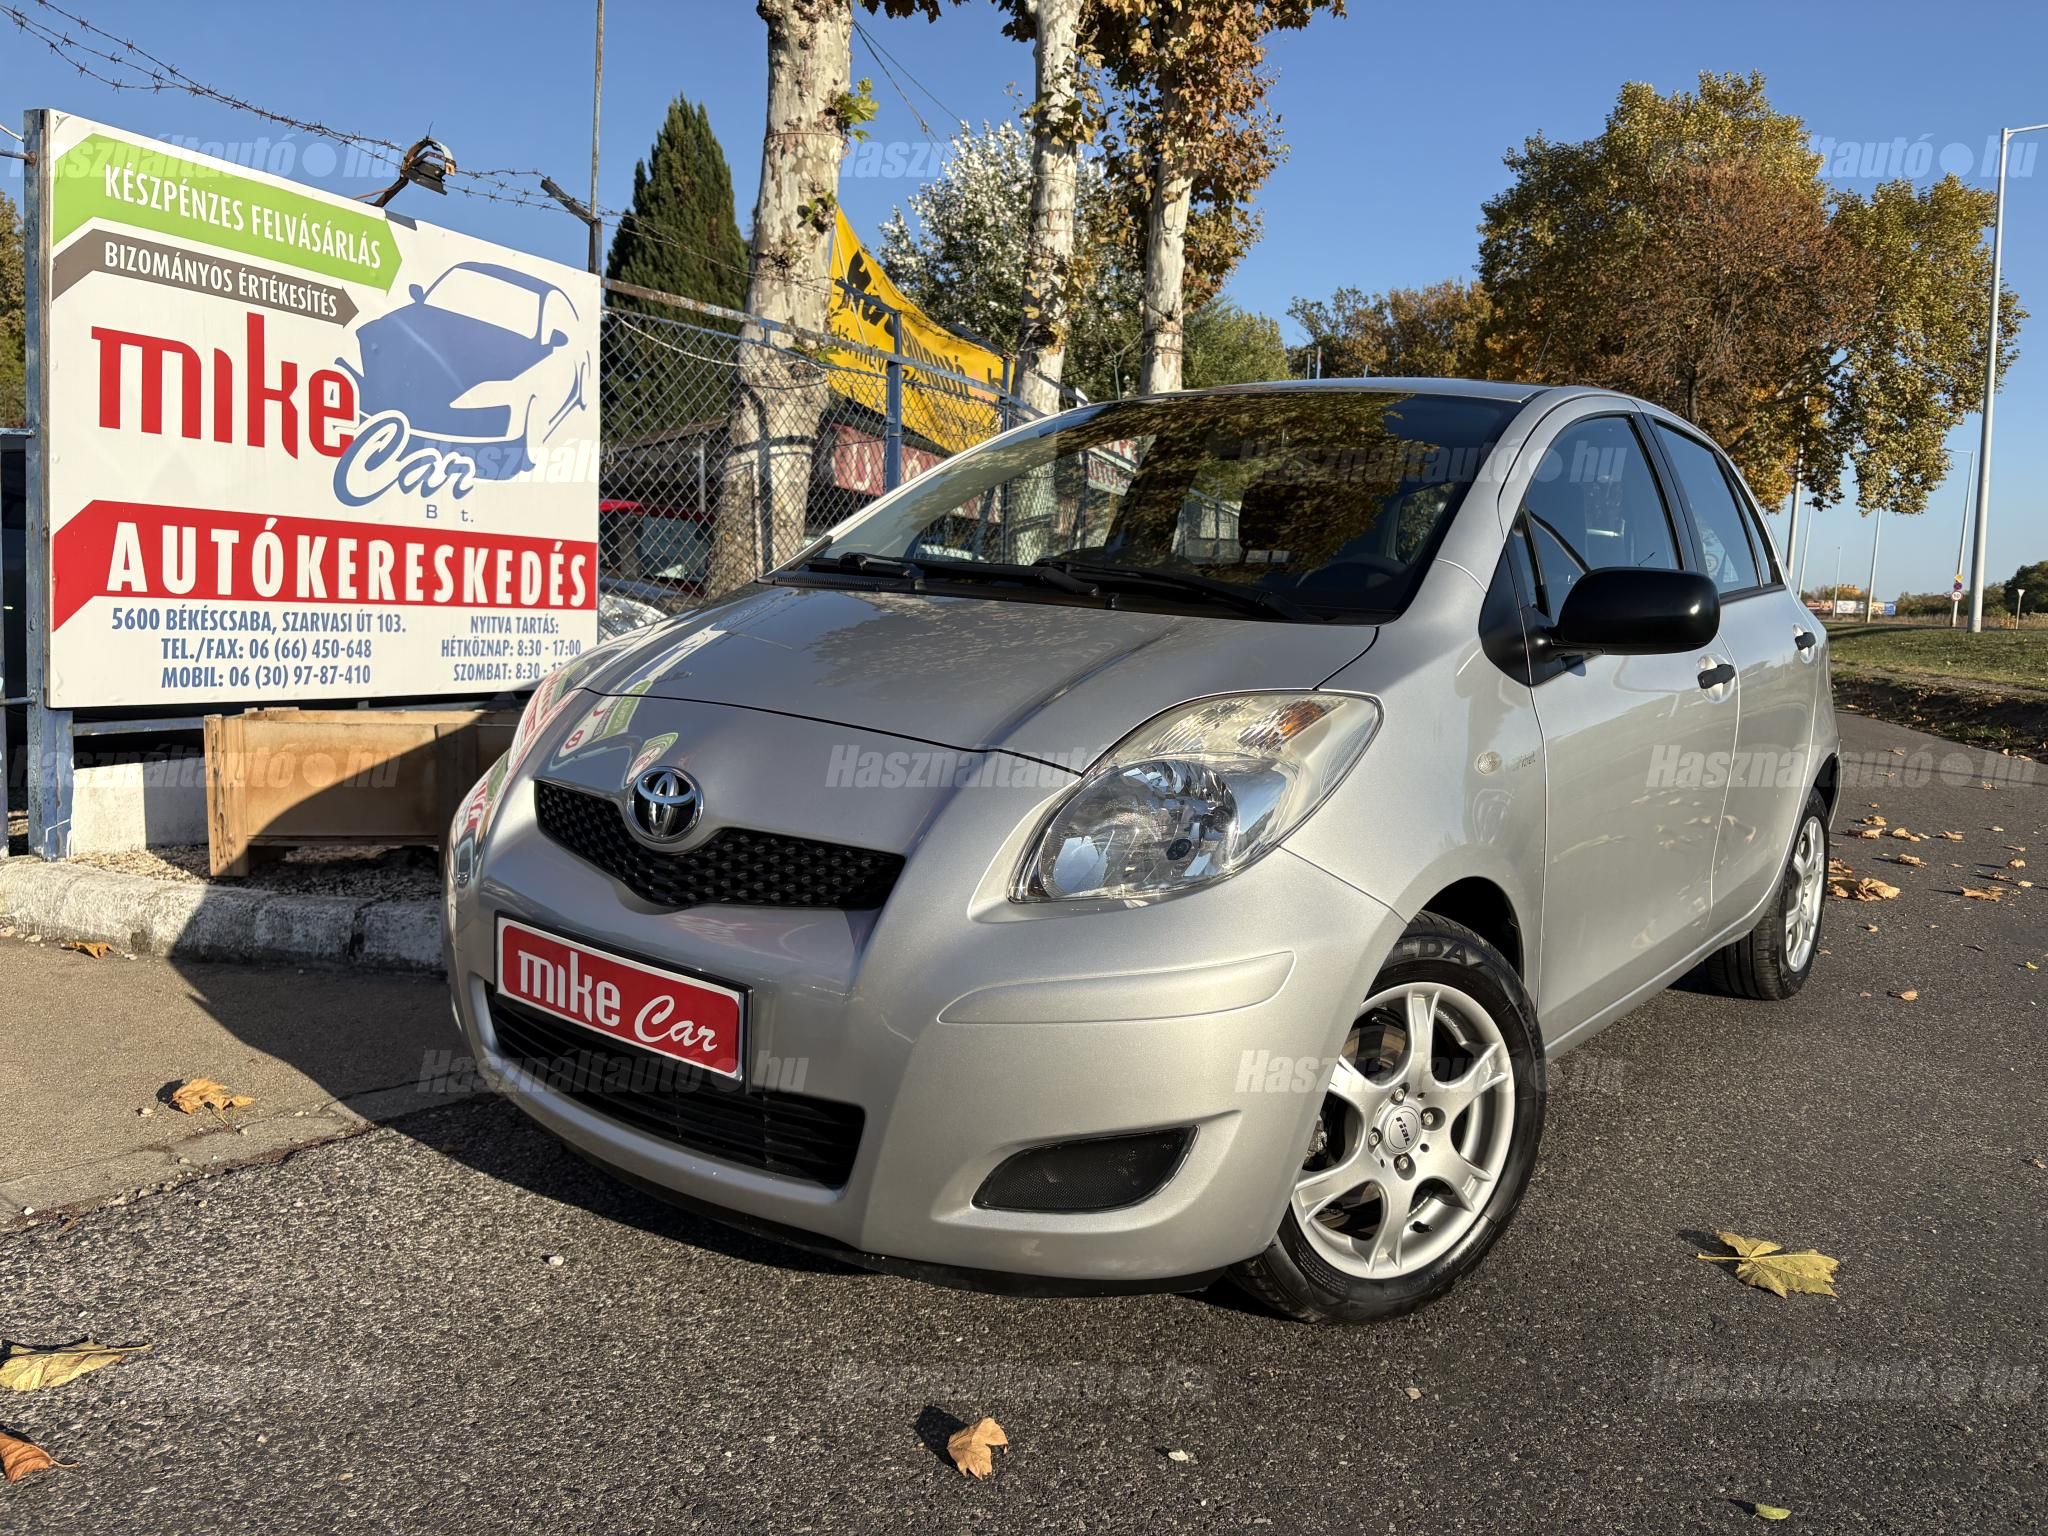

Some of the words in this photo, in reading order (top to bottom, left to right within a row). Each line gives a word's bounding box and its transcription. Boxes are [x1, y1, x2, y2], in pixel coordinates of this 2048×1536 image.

[105, 164, 245, 231] KÉSZPÉNZES
[251, 205, 381, 269] FELVÁSÁRLÁS
[238, 268, 337, 317] ÉRTÉKESÍTÉS
[91, 312, 354, 459] mike
[333, 416, 474, 507] Car
[106, 518, 587, 607] AUTÓKERESKEDÉS
[112, 607, 160, 630] 5600
[166, 604, 277, 635] BÉKÉSCSABA,
[282, 611, 352, 632] SZARVASI
[356, 609, 373, 632] ÚT
[377, 613, 407, 632] 103.
[470, 616, 512, 634] NYITVA
[516, 613, 559, 634] TARTÁS:
[161, 637, 244, 662] TEL./FAX:
[249, 638, 269, 659] 06
[274, 638, 307, 661] (66)
[311, 639, 372, 659] 450-648
[441, 635, 514, 657] HÉTKÖZNAP:
[517, 639, 542, 656] 8:30
[553, 639, 581, 656] 17:00
[161, 666, 224, 688] MOBIL:
[228, 665, 250, 687] 06
[255, 665, 289, 689] (30)
[293, 664, 371, 686] 97-87-410
[453, 663, 512, 681] SZOMBAT:
[515, 662, 540, 679] 8:30
[518, 950, 620, 1027] mike
[634, 995, 718, 1052] Car
